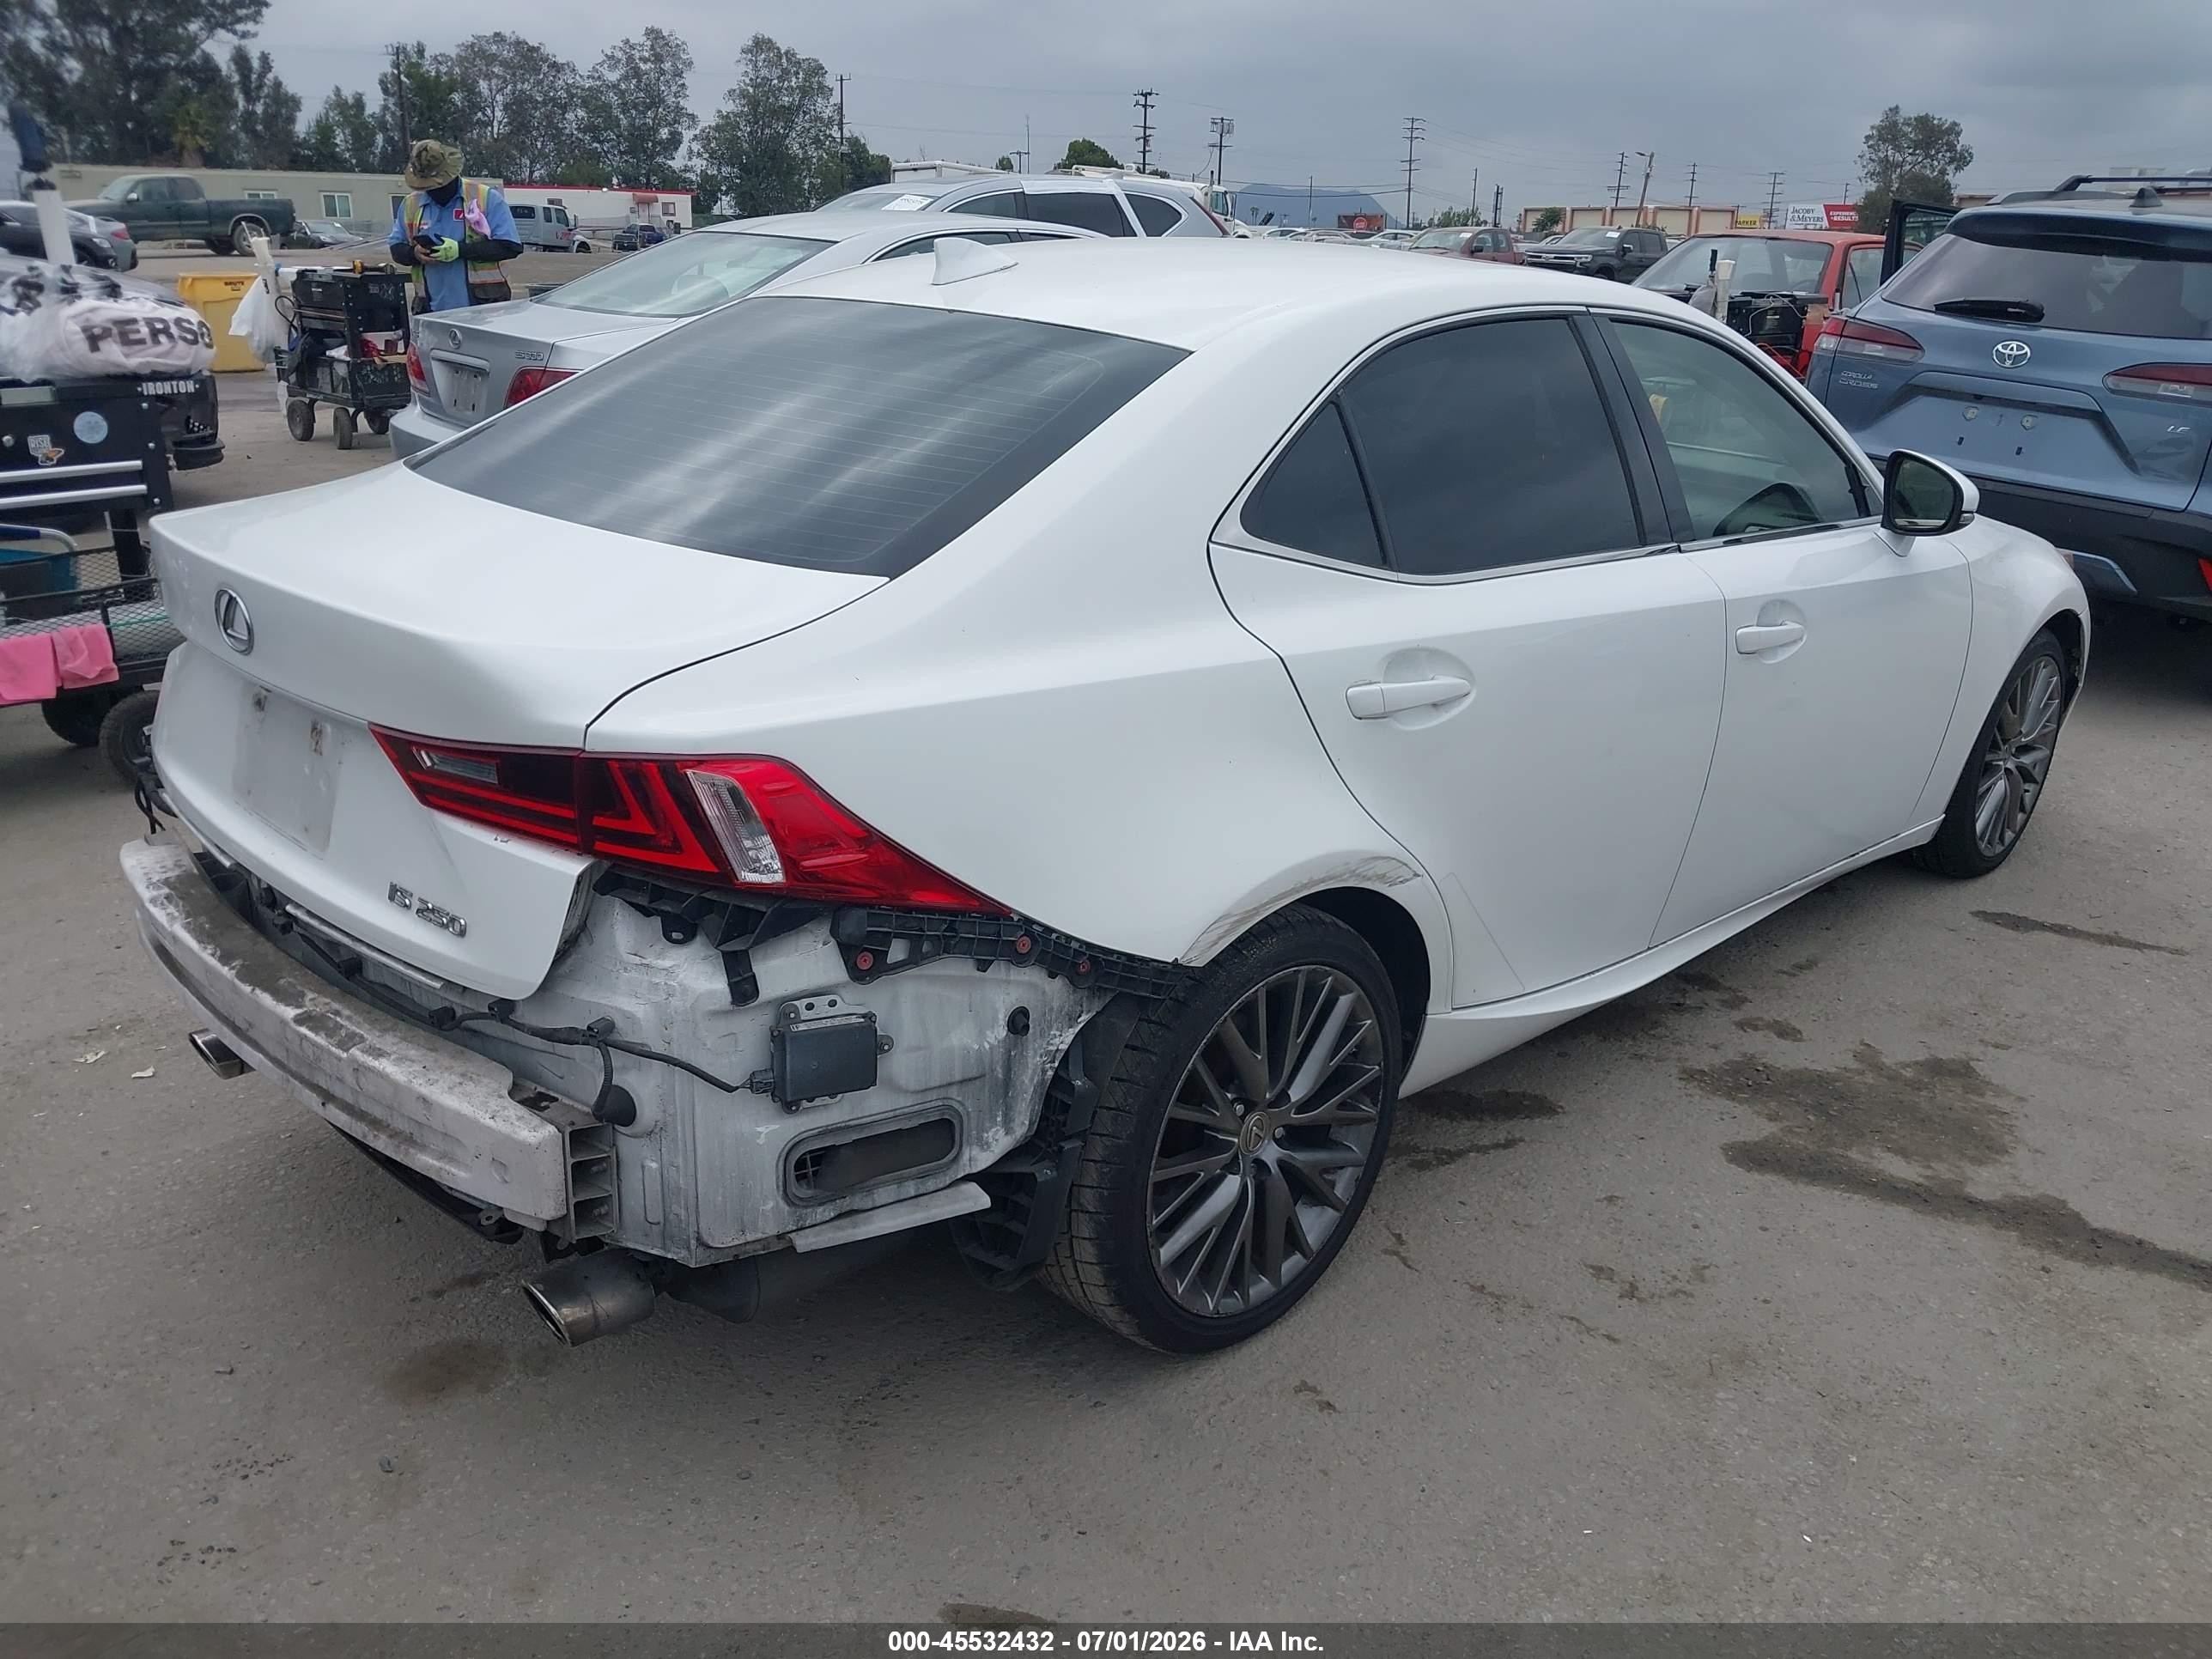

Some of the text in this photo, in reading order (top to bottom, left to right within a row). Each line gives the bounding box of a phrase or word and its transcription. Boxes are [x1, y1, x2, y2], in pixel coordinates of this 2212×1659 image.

[1841, 370, 1873, 380] COROLLA
[142, 380, 195, 395] IRONTON
[1839, 378, 1879, 389] CROSS
[387, 881, 467, 939] IS 250
